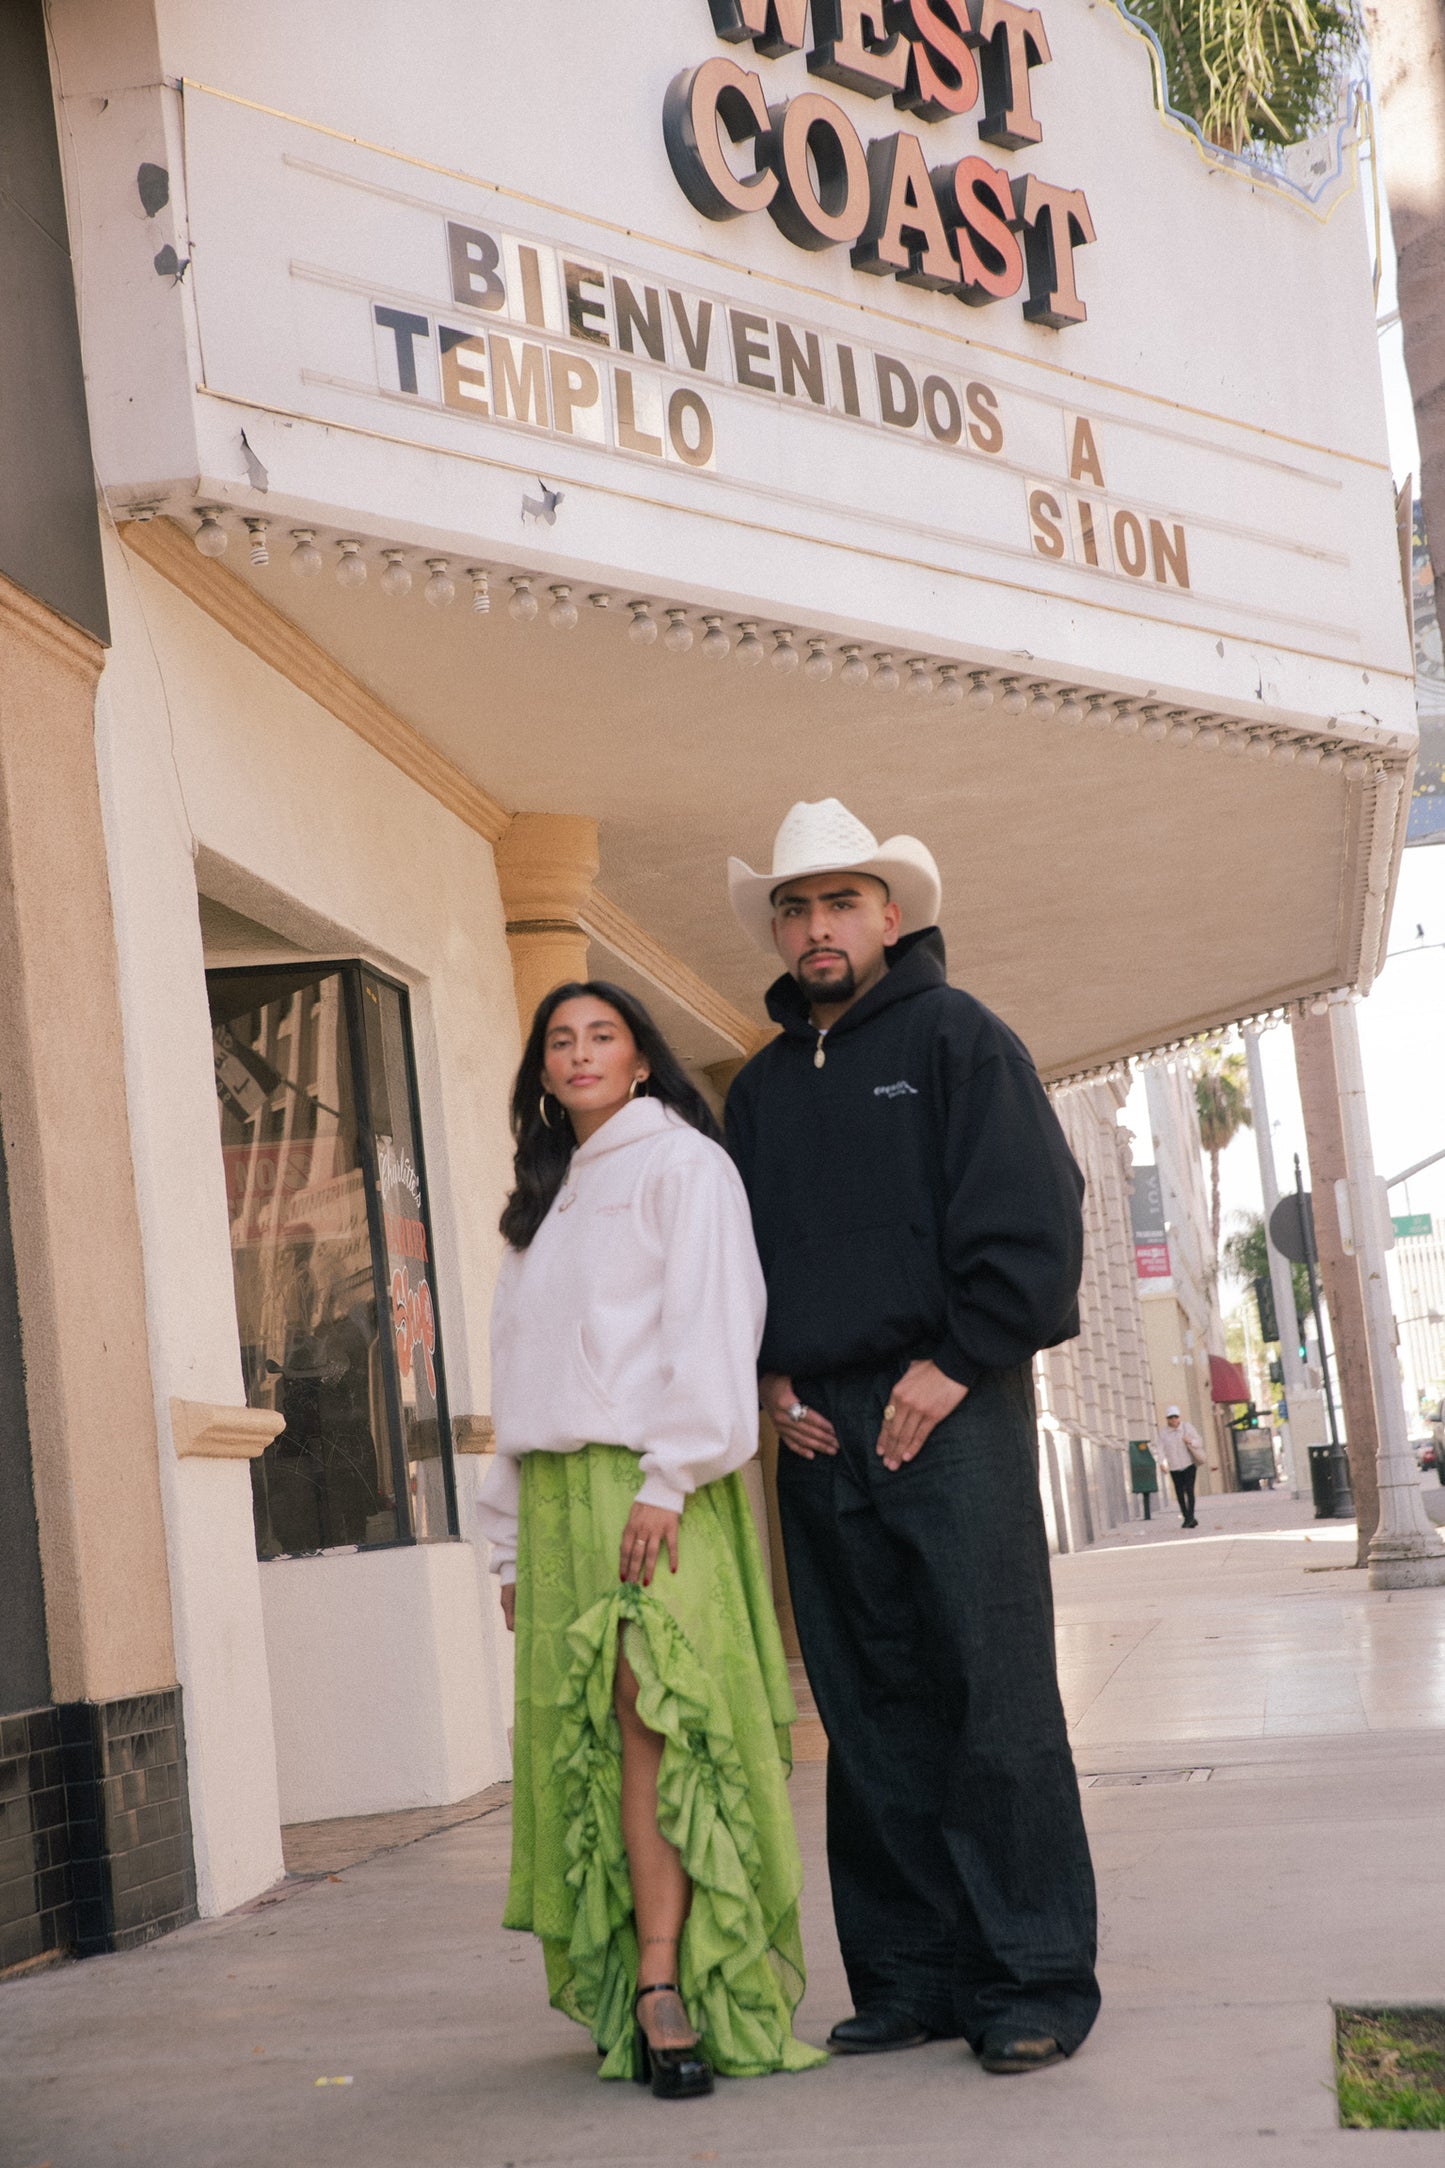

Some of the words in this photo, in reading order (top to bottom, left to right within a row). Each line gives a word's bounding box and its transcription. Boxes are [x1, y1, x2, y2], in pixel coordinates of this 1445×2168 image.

[663, 57, 1098, 330] COAST
[374, 305, 714, 467] TEMPLO
[1029, 489, 1190, 589] SION
[447, 220, 1004, 453] BIENVENIDOS
[1070, 416, 1106, 488] A
[391, 1265, 436, 1400] Shop
